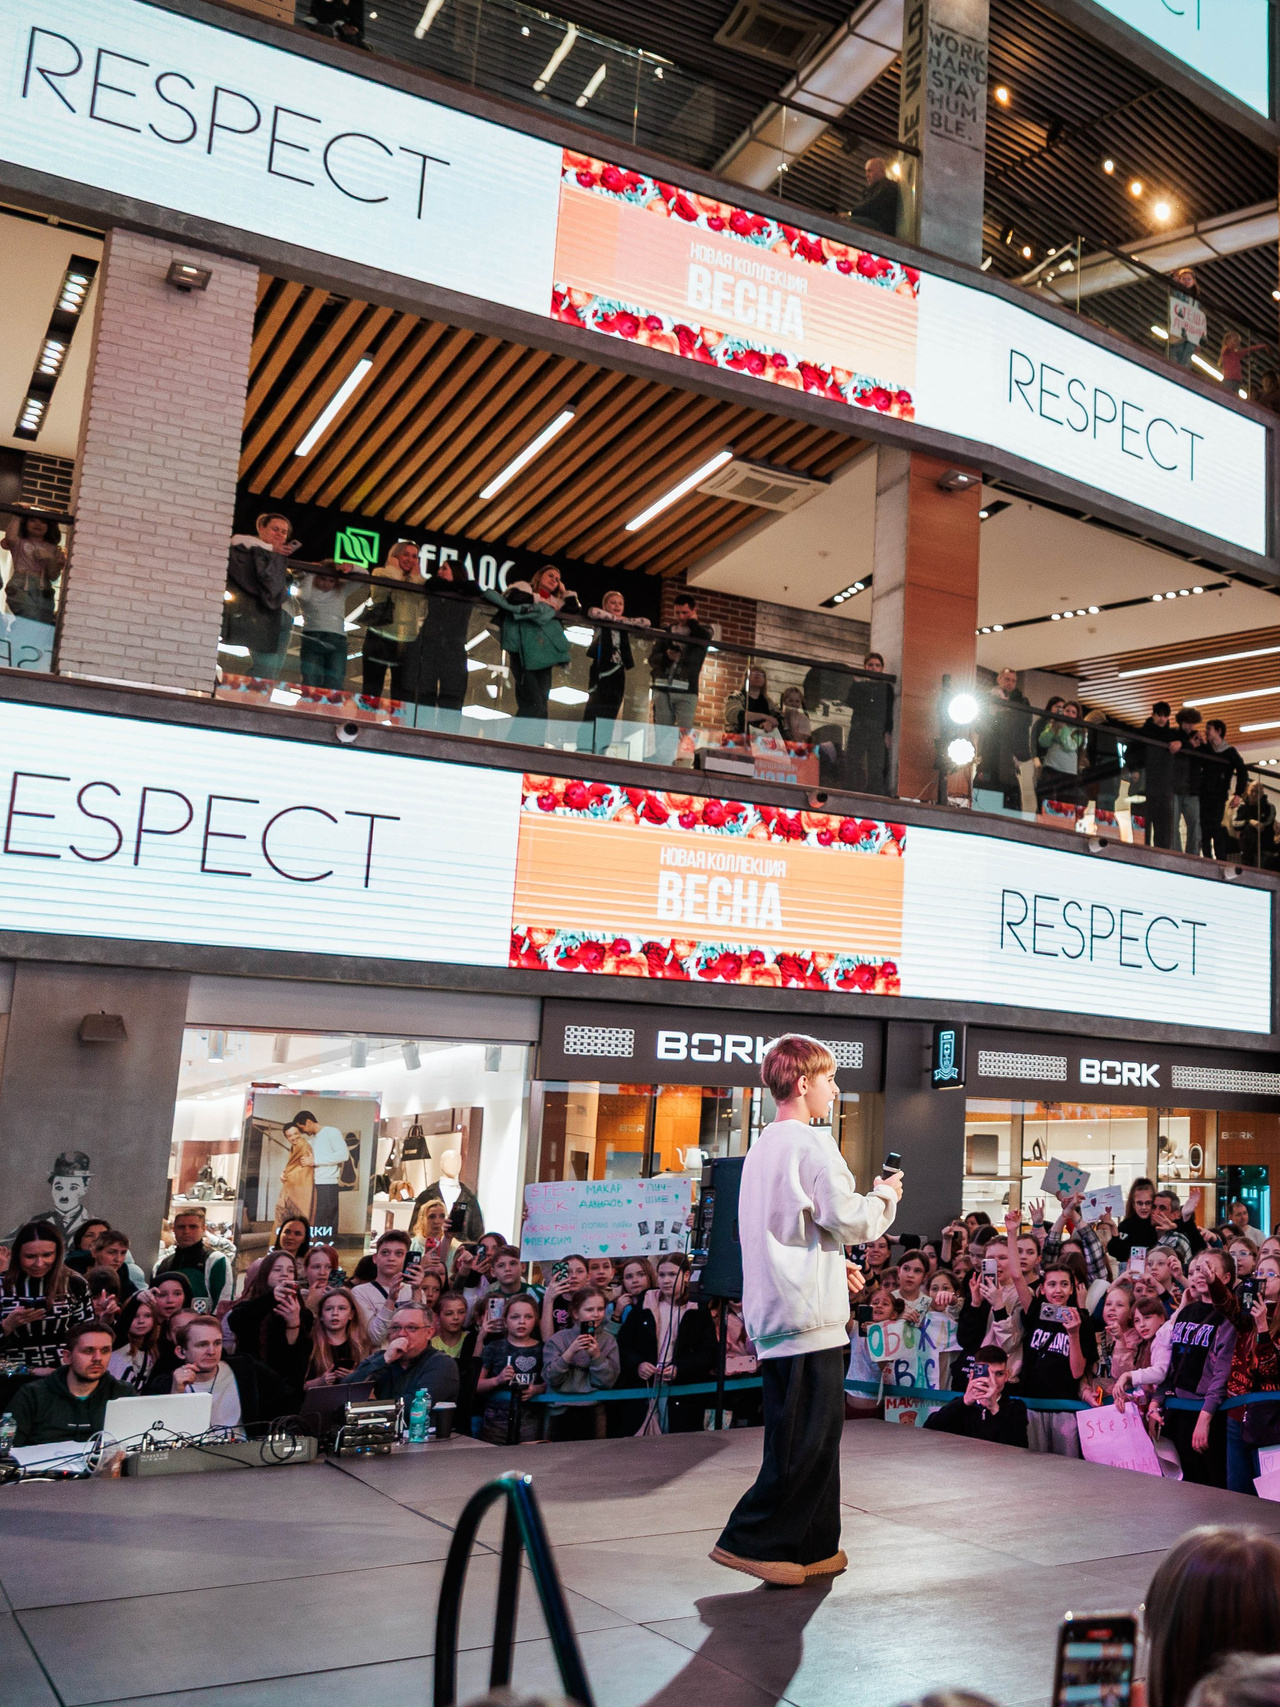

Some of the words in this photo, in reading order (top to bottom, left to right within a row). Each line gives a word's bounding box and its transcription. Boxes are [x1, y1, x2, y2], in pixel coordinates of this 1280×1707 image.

[928, 27, 986, 65] WORK
[928, 49, 986, 85] HARD
[931, 69, 980, 102] STAY
[22, 26, 451, 220] RESPECT
[689, 241, 733, 270] НОВАЯ
[686, 262, 805, 342] ВЕСНА
[1009, 348, 1205, 481] RESPECT
[659, 846, 706, 870] НОВАЯ
[707, 852, 787, 878] КОЛЛЕКЦИЯ
[656, 870, 783, 930] ВЕСНА
[1000, 888, 1207, 976] RESPECT
[1079, 1057, 1160, 1089] BORK
[585, 1183, 623, 1195] МАКАР
[524, 1236, 573, 1247] ФЛЕКСИМ
[894, 1356, 936, 1389] ВАС
